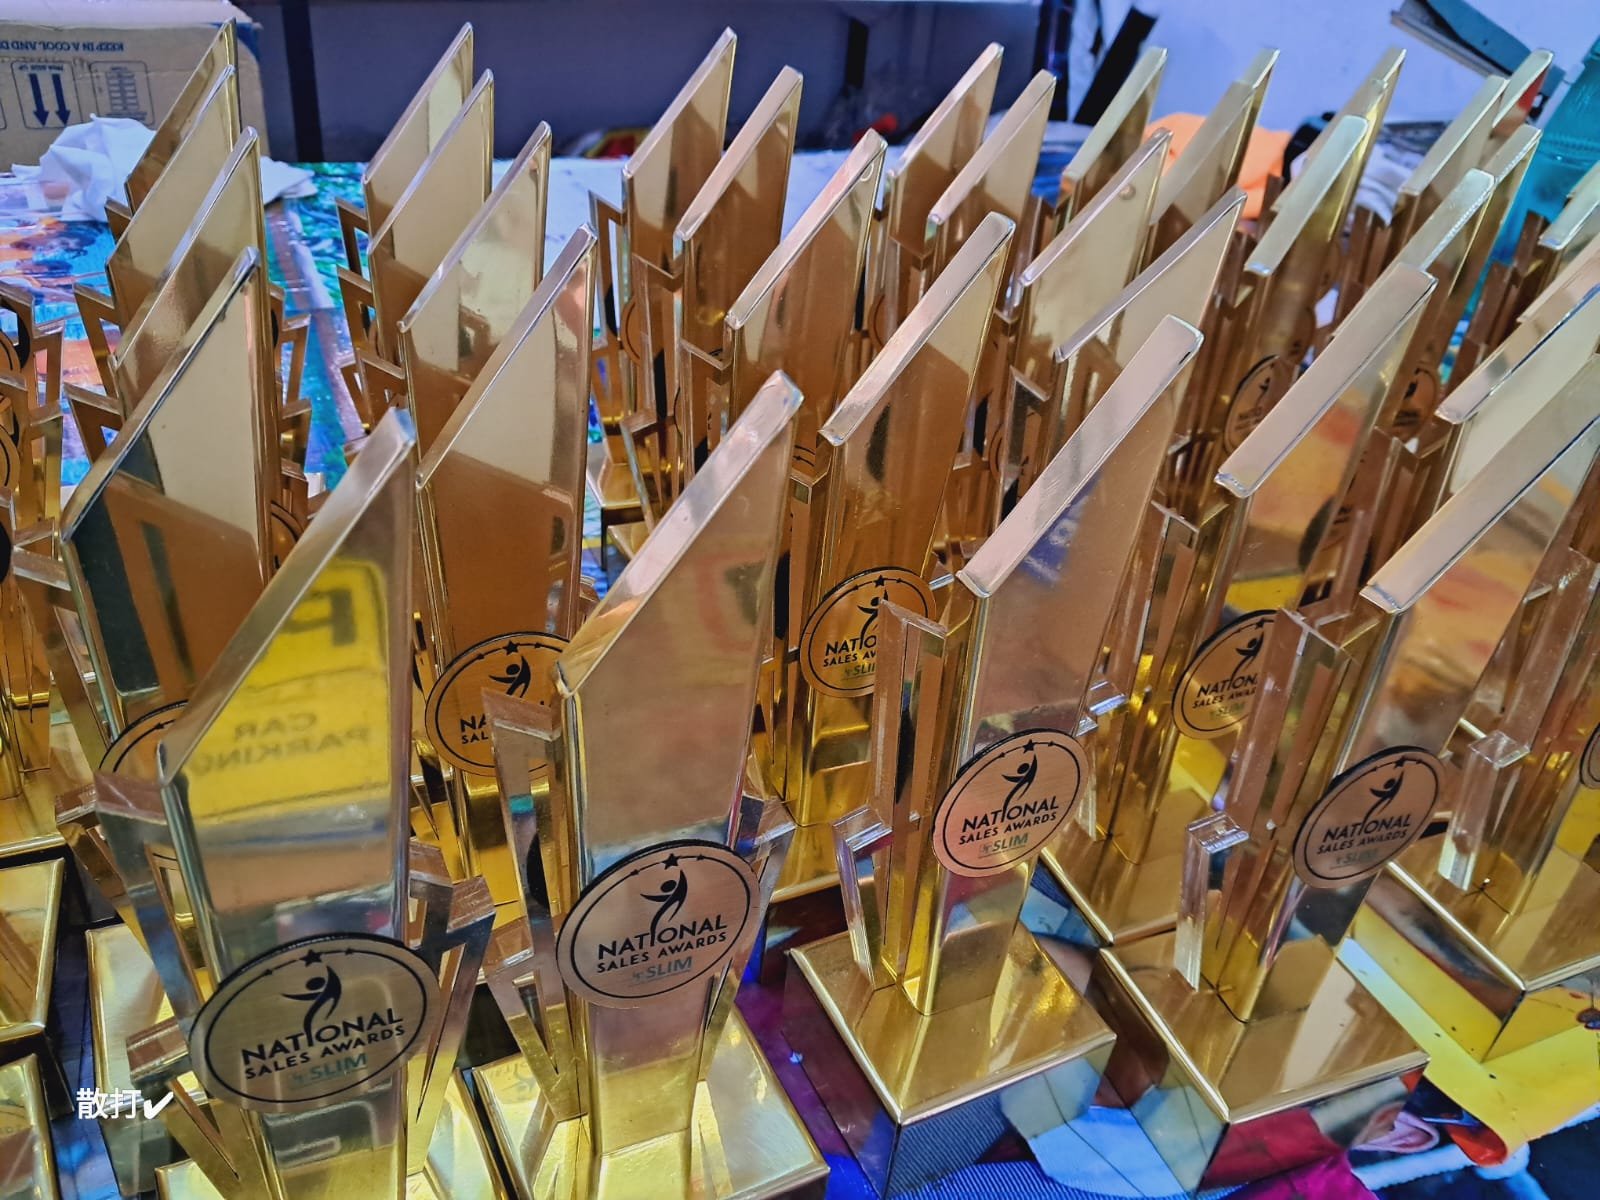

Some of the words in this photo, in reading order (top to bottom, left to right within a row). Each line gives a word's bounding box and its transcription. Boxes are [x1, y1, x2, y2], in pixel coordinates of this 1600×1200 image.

[11, 41, 37, 50] AND
[71, 42, 80, 50] A
[83, 42, 94, 51] IN
[96, 42, 124, 52] KEEP
[823, 653, 858, 668] SALES
[1197, 673, 1258, 698] NATION
[1192, 694, 1224, 708] SALES
[462, 731, 489, 744] SAL
[962, 796, 1059, 832] NATIONAL
[959, 827, 998, 846] SALES
[1004, 812, 1057, 834] AWARDS
[1322, 814, 1412, 843] NATIONAL
[992, 833, 1029, 852] SLIM
[1316, 840, 1354, 855] SALES
[1357, 830, 1406, 847] AWARDS
[598, 914, 728, 960] NATIONAL
[597, 951, 650, 974] SALES
[658, 931, 727, 960] AWARDS
[646, 956, 693, 979] SLIM
[241, 1008, 403, 1065] NATIONAL
[245, 1054, 310, 1080] SALES
[321, 1025, 406, 1058] AWARDS
[309, 1053, 368, 1081] SLIM
